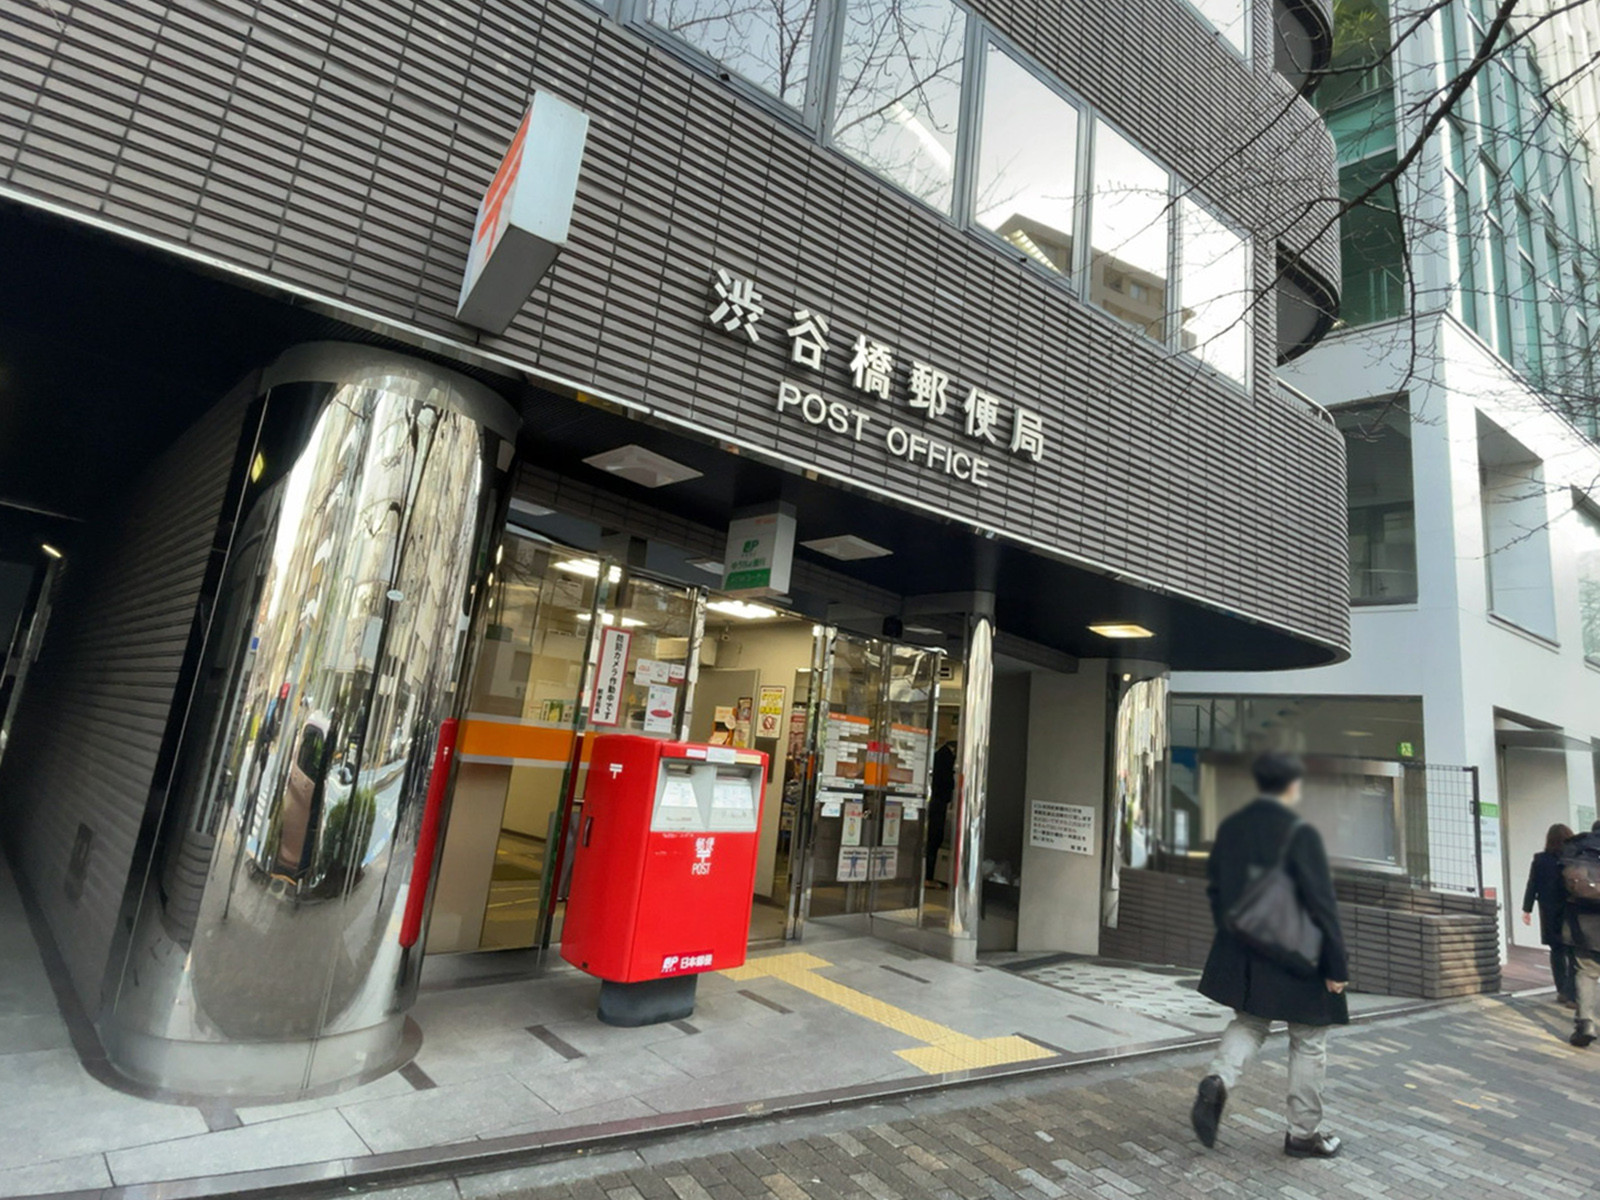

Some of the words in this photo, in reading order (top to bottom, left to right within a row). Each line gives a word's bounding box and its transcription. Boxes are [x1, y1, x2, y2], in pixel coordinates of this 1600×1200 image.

[709, 268, 1045, 463] 渋谷橋郵便局
[776, 381, 870, 440] POST
[886, 426, 990, 488] OFFICE
[604, 634, 624, 720] 防犯カメラ作動中です
[691, 863, 711, 876] POST
[680, 954, 713, 969] 日本郵便
